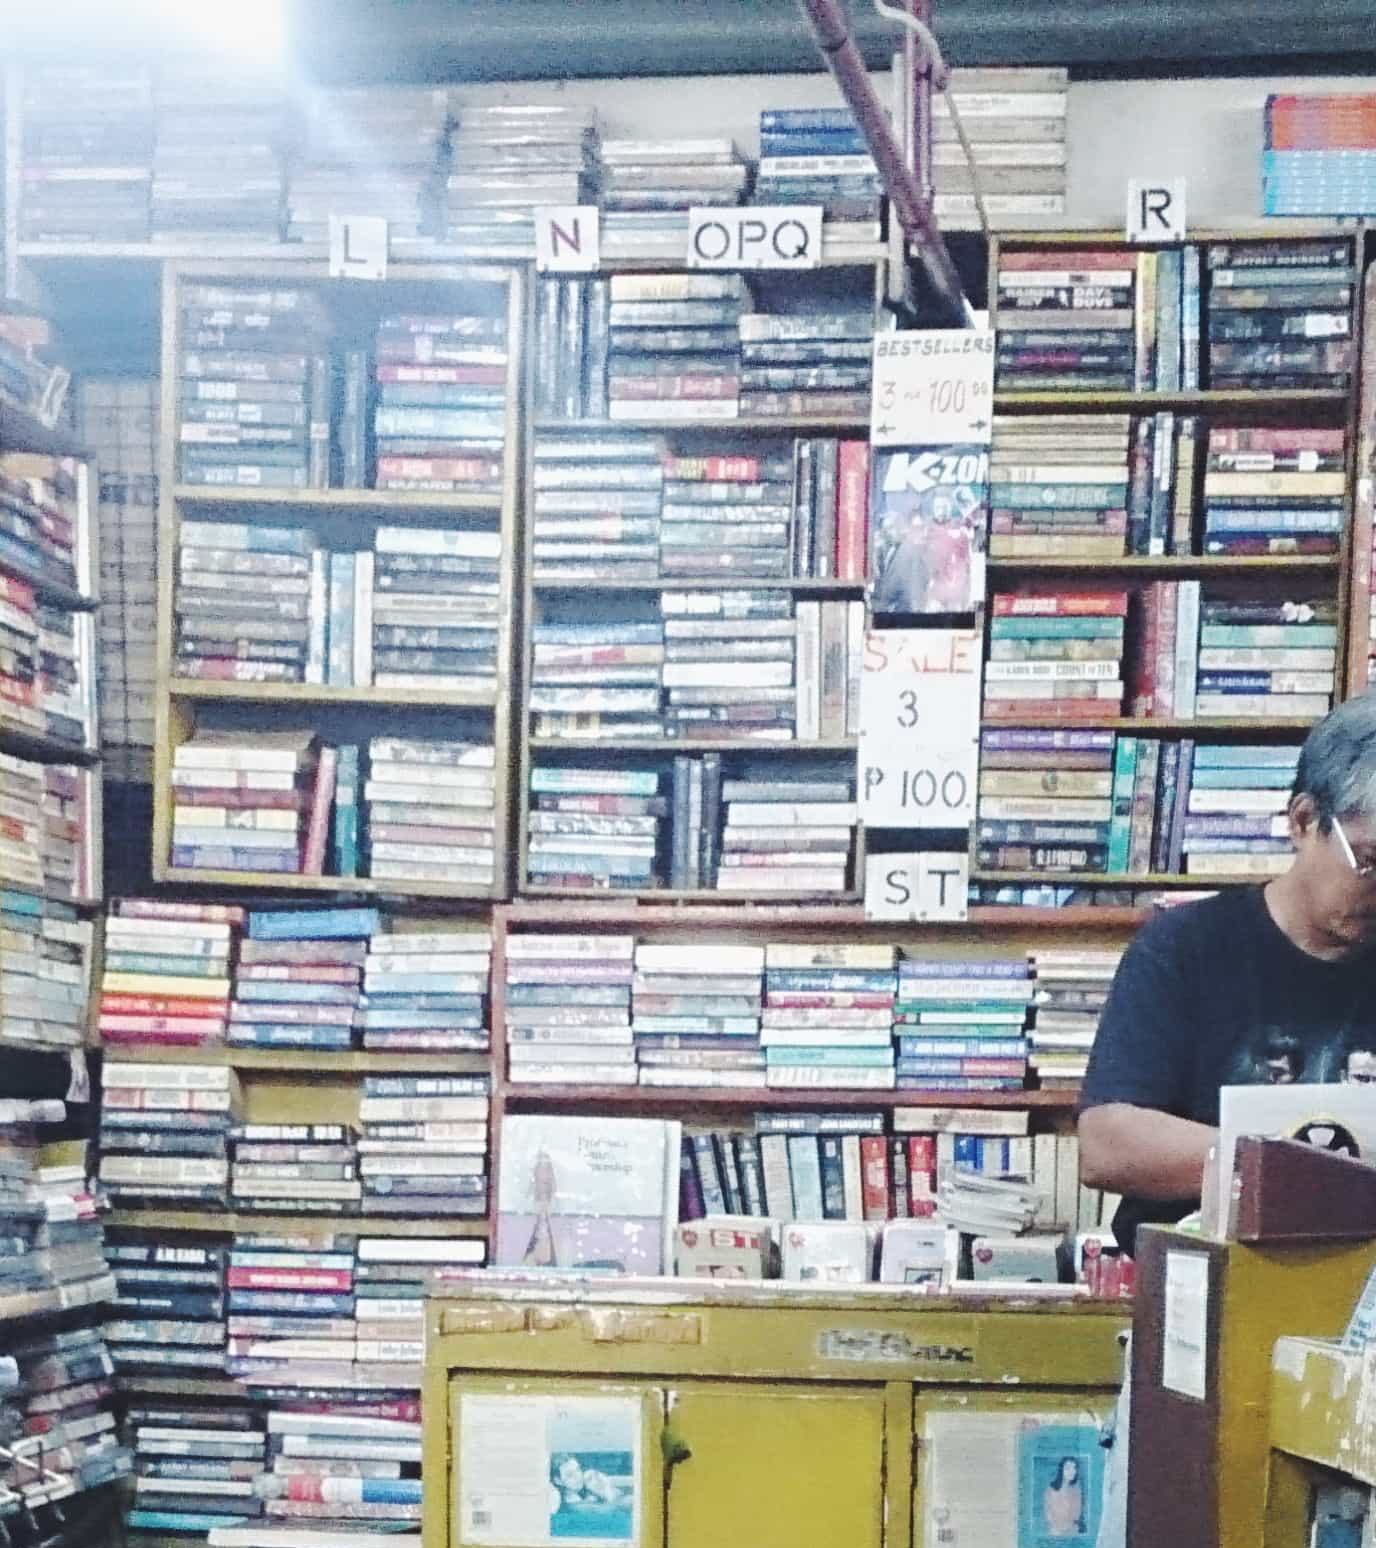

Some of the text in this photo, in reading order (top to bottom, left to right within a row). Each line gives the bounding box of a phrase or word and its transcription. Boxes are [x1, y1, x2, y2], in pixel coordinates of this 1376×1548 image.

[1140, 188, 1173, 231] R
[343, 226, 369, 264] L
[549, 217, 582, 258] N
[693, 219, 811, 262] OPQ
[879, 380, 897, 411] 3
[896, 689, 919, 728] 3
